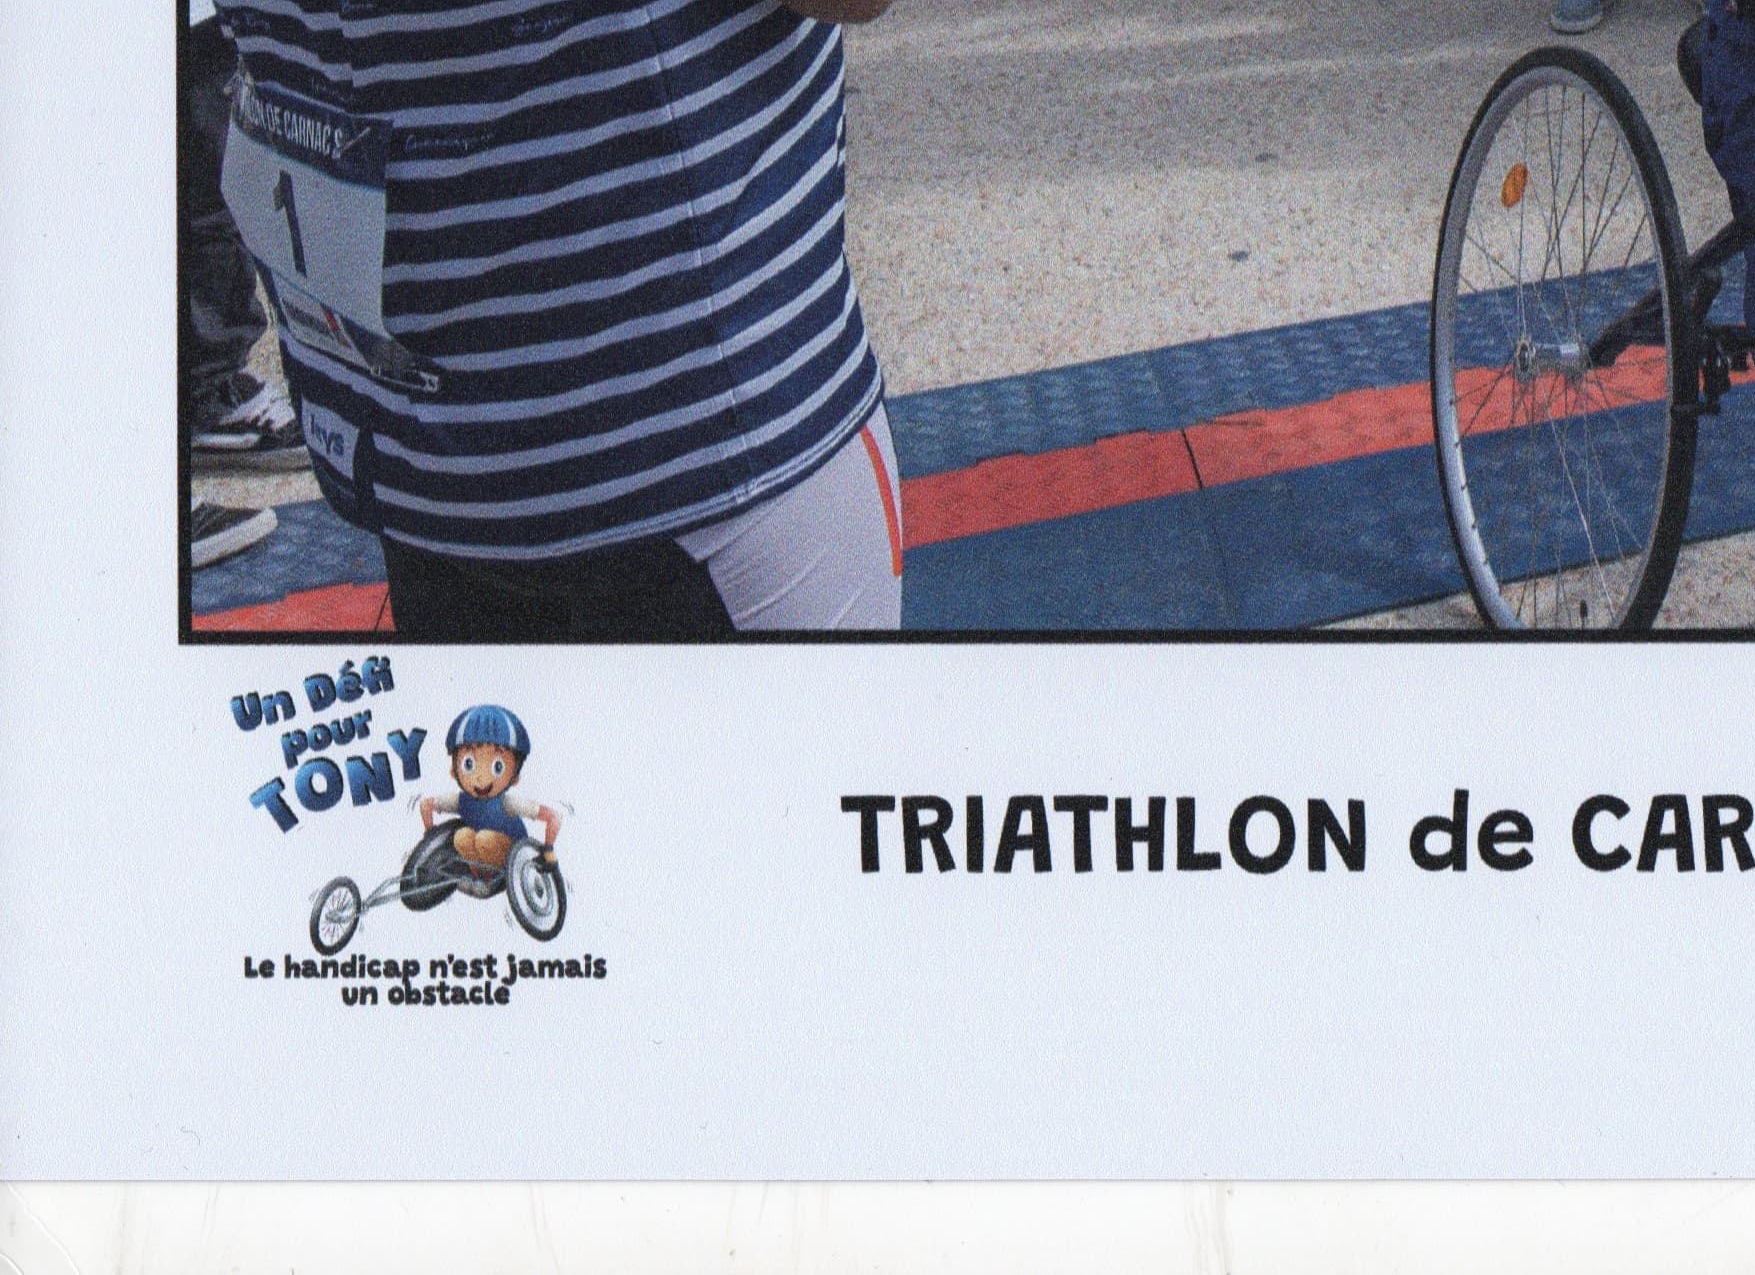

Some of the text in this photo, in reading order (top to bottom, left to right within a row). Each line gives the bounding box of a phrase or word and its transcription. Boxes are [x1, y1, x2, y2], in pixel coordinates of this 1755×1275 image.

[265, 101, 284, 137] DE
[283, 109, 332, 157] CARNAC
[272, 169, 308, 279] 1
